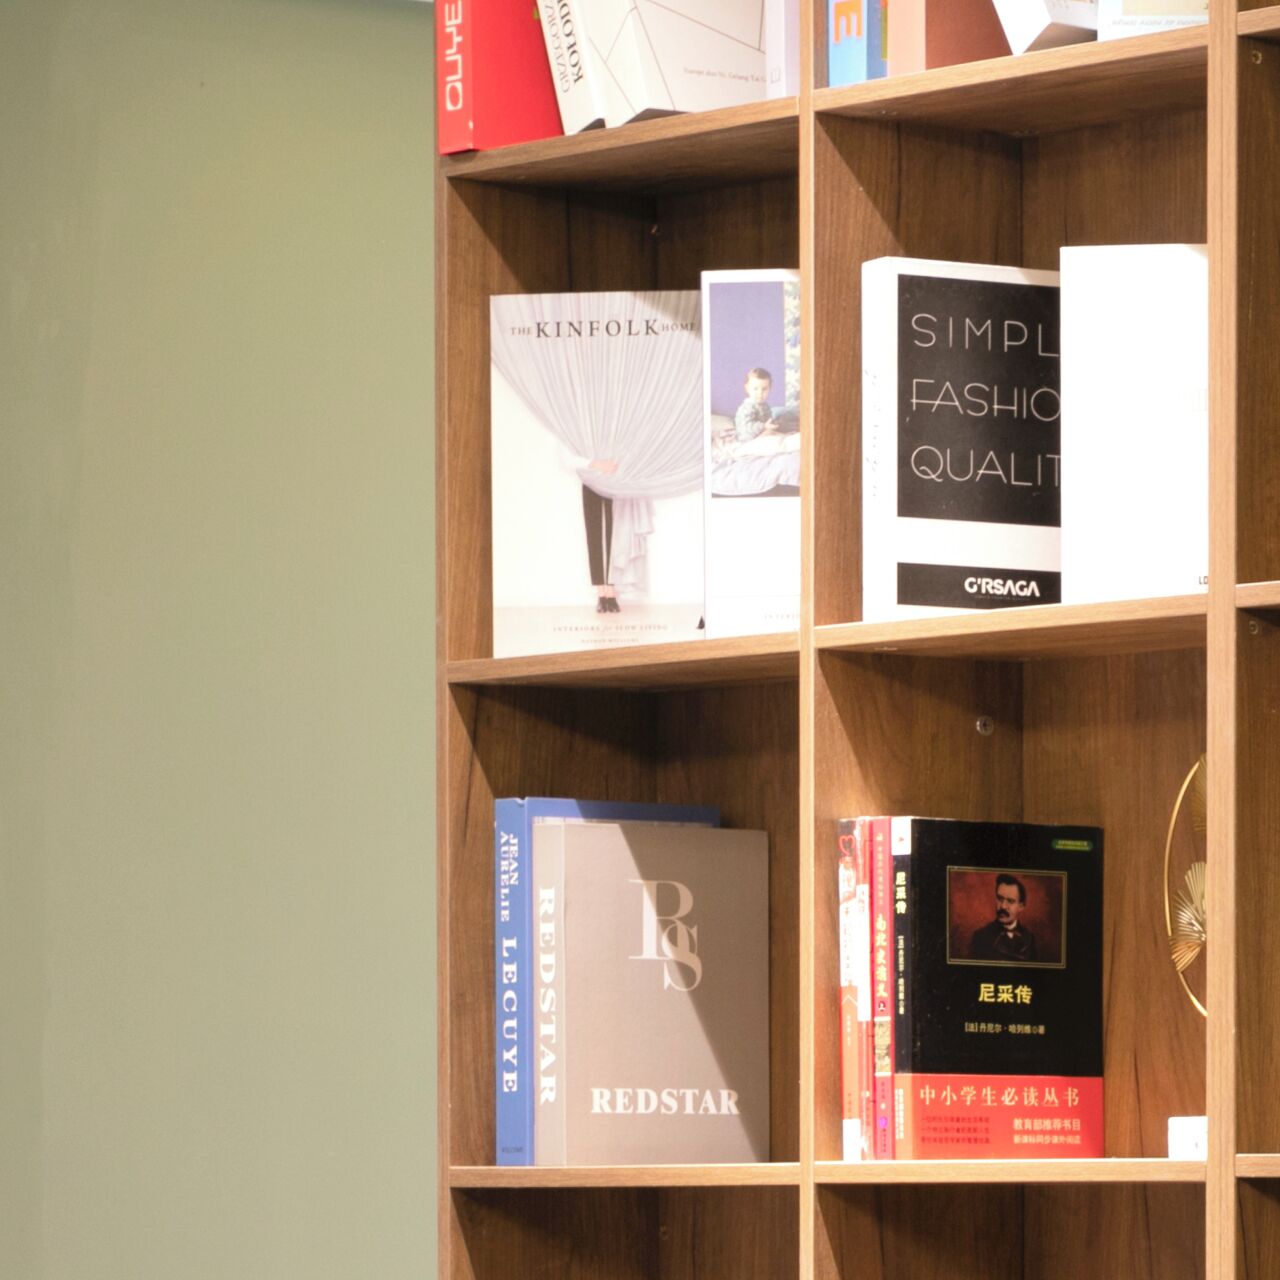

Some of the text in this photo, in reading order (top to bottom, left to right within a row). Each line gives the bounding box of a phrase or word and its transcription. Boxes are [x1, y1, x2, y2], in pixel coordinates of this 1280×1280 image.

[535, 319, 660, 338] KINFOLK
[661, 322, 695, 332] HOME
[910, 378, 1061, 421] FASHIO
[500, 831, 510, 923] AURELIE
[508, 834, 519, 885] JEAN
[502, 935, 518, 1093] LECUYE
[538, 887, 556, 1106] REDSTAR
[977, 983, 1034, 1006] 尼采传
[590, 1088, 740, 1115] REDSTAR
[919, 1085, 1080, 1107] 中小学生必读丛书
